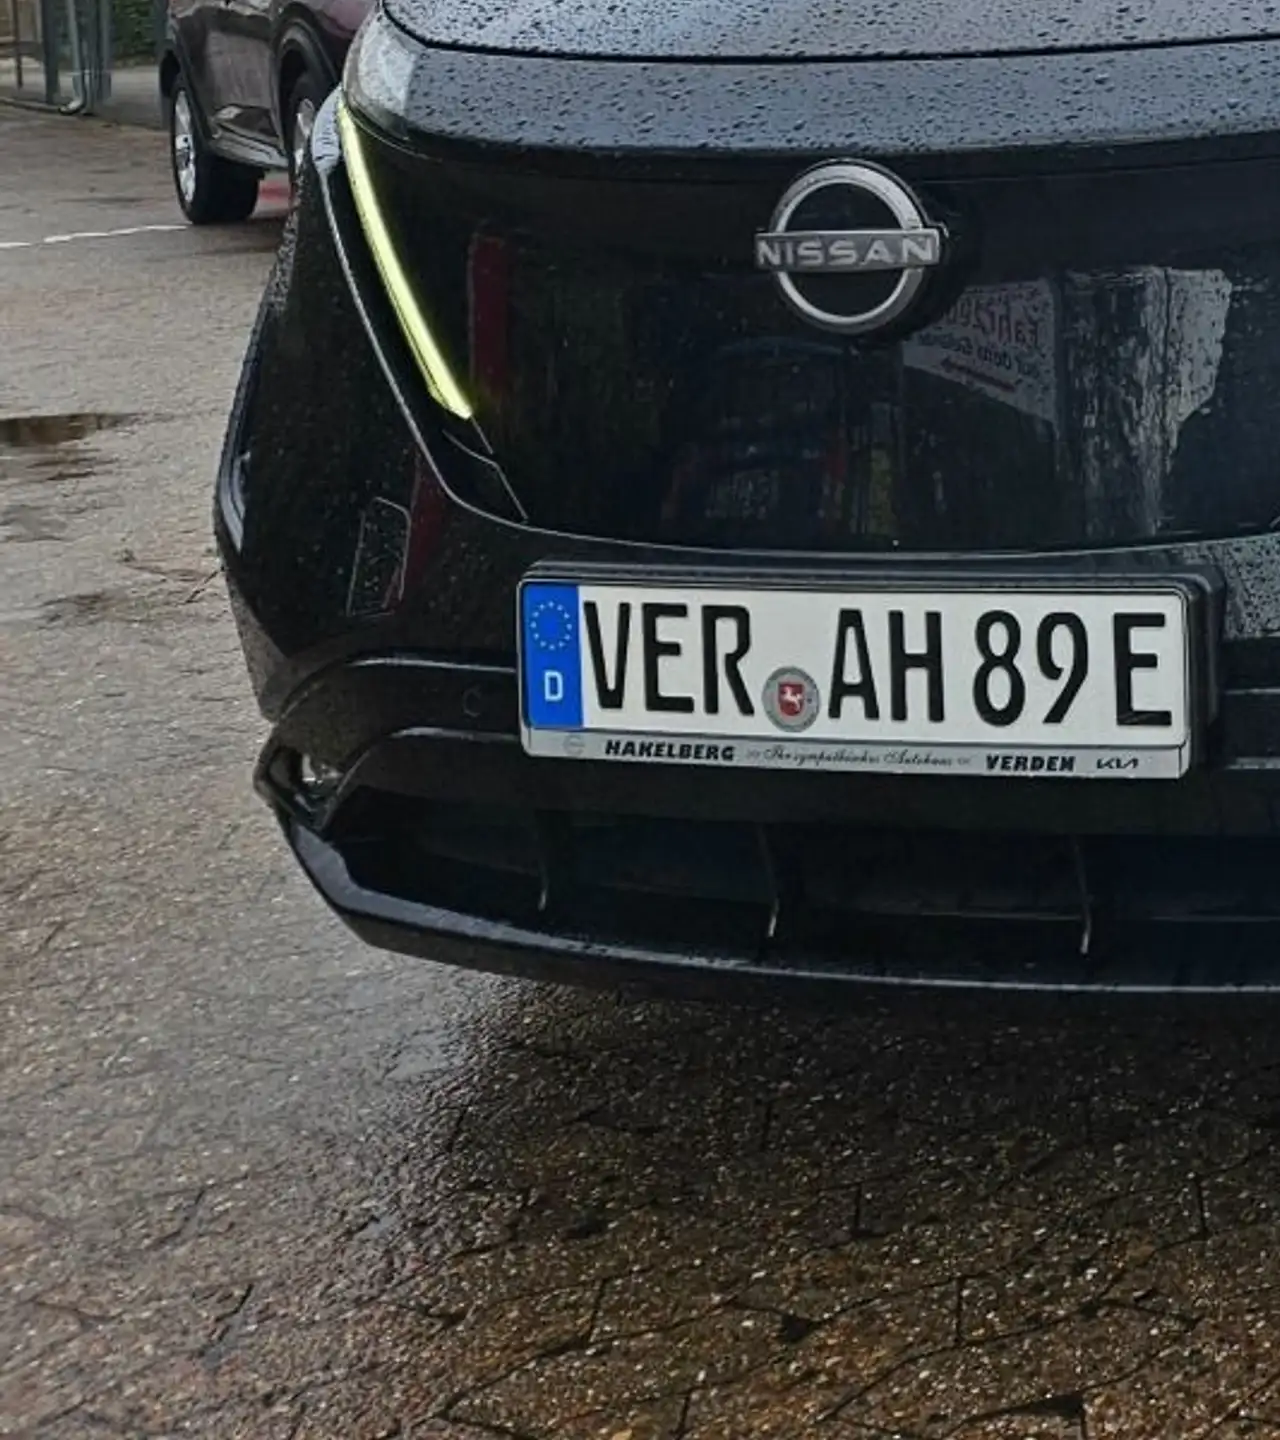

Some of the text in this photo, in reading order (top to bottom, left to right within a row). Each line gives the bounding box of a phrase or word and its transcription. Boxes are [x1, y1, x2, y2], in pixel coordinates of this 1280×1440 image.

[756, 236, 937, 266] NISSAN
[584, 601, 755, 715] VER
[827, 608, 945, 723] AH
[544, 670, 563, 702] D
[605, 739, 736, 762] HAKELBERG
[986, 754, 1076, 772] VERDEN
